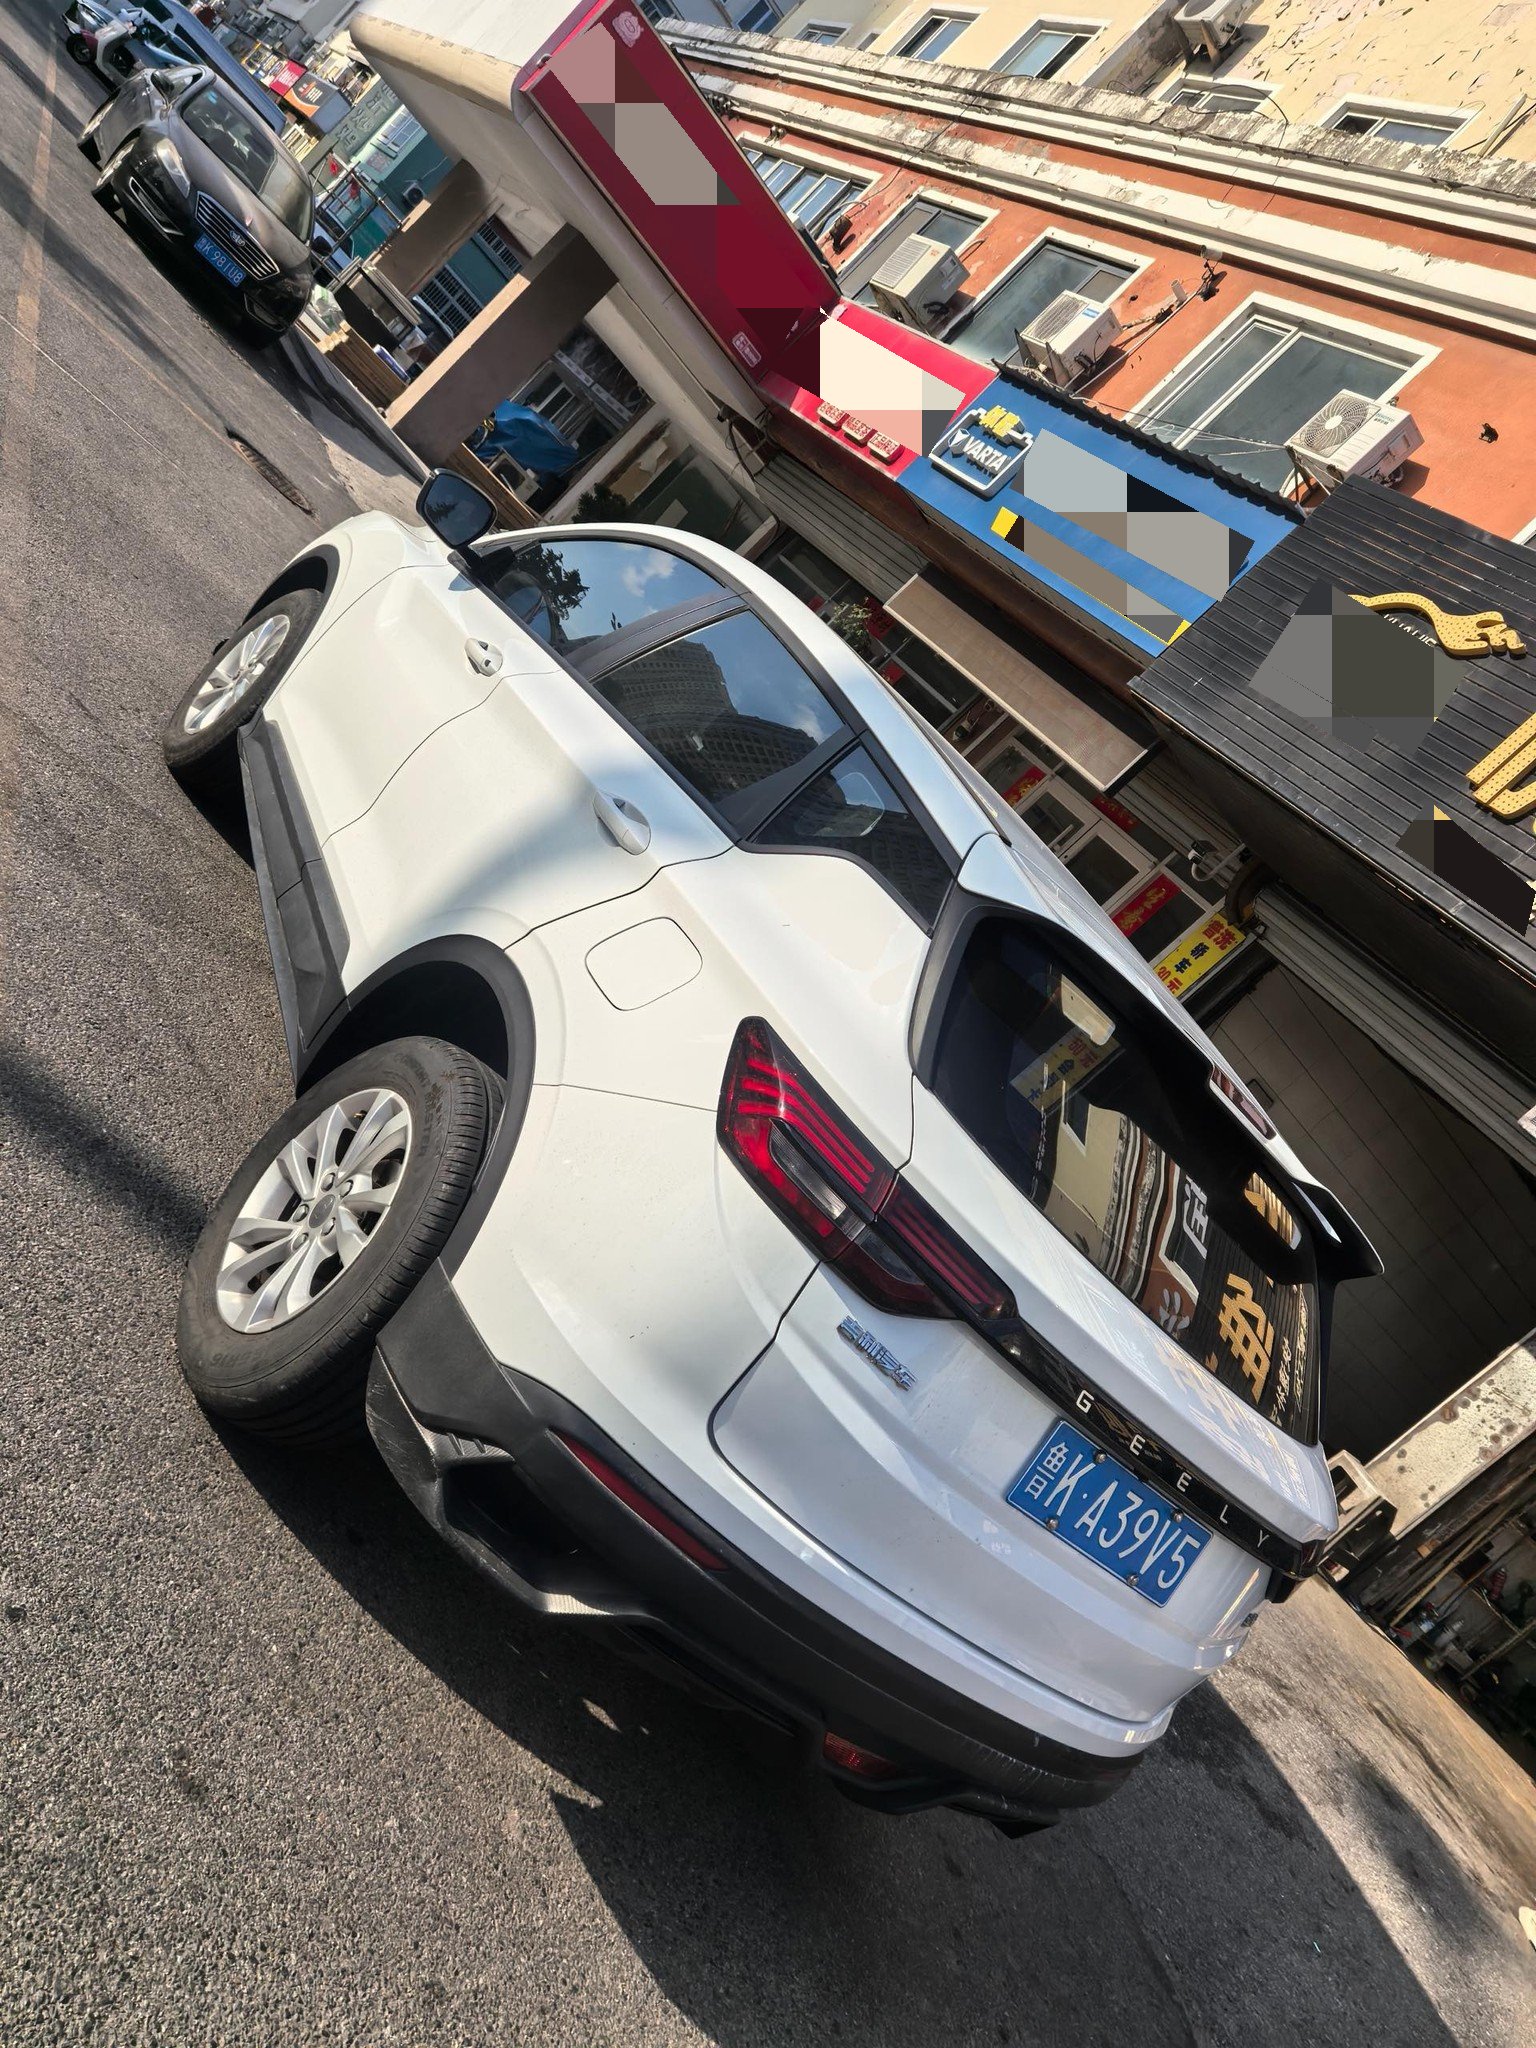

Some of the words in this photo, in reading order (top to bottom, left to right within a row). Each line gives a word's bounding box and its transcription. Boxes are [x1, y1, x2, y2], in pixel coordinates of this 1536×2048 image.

[963, 436, 1009, 471] VARTA
[1173, 941, 1210, 974] 轿车
[836, 1316, 918, 1391] 吉利汽车
[1075, 1390, 1270, 1548] GEELY
